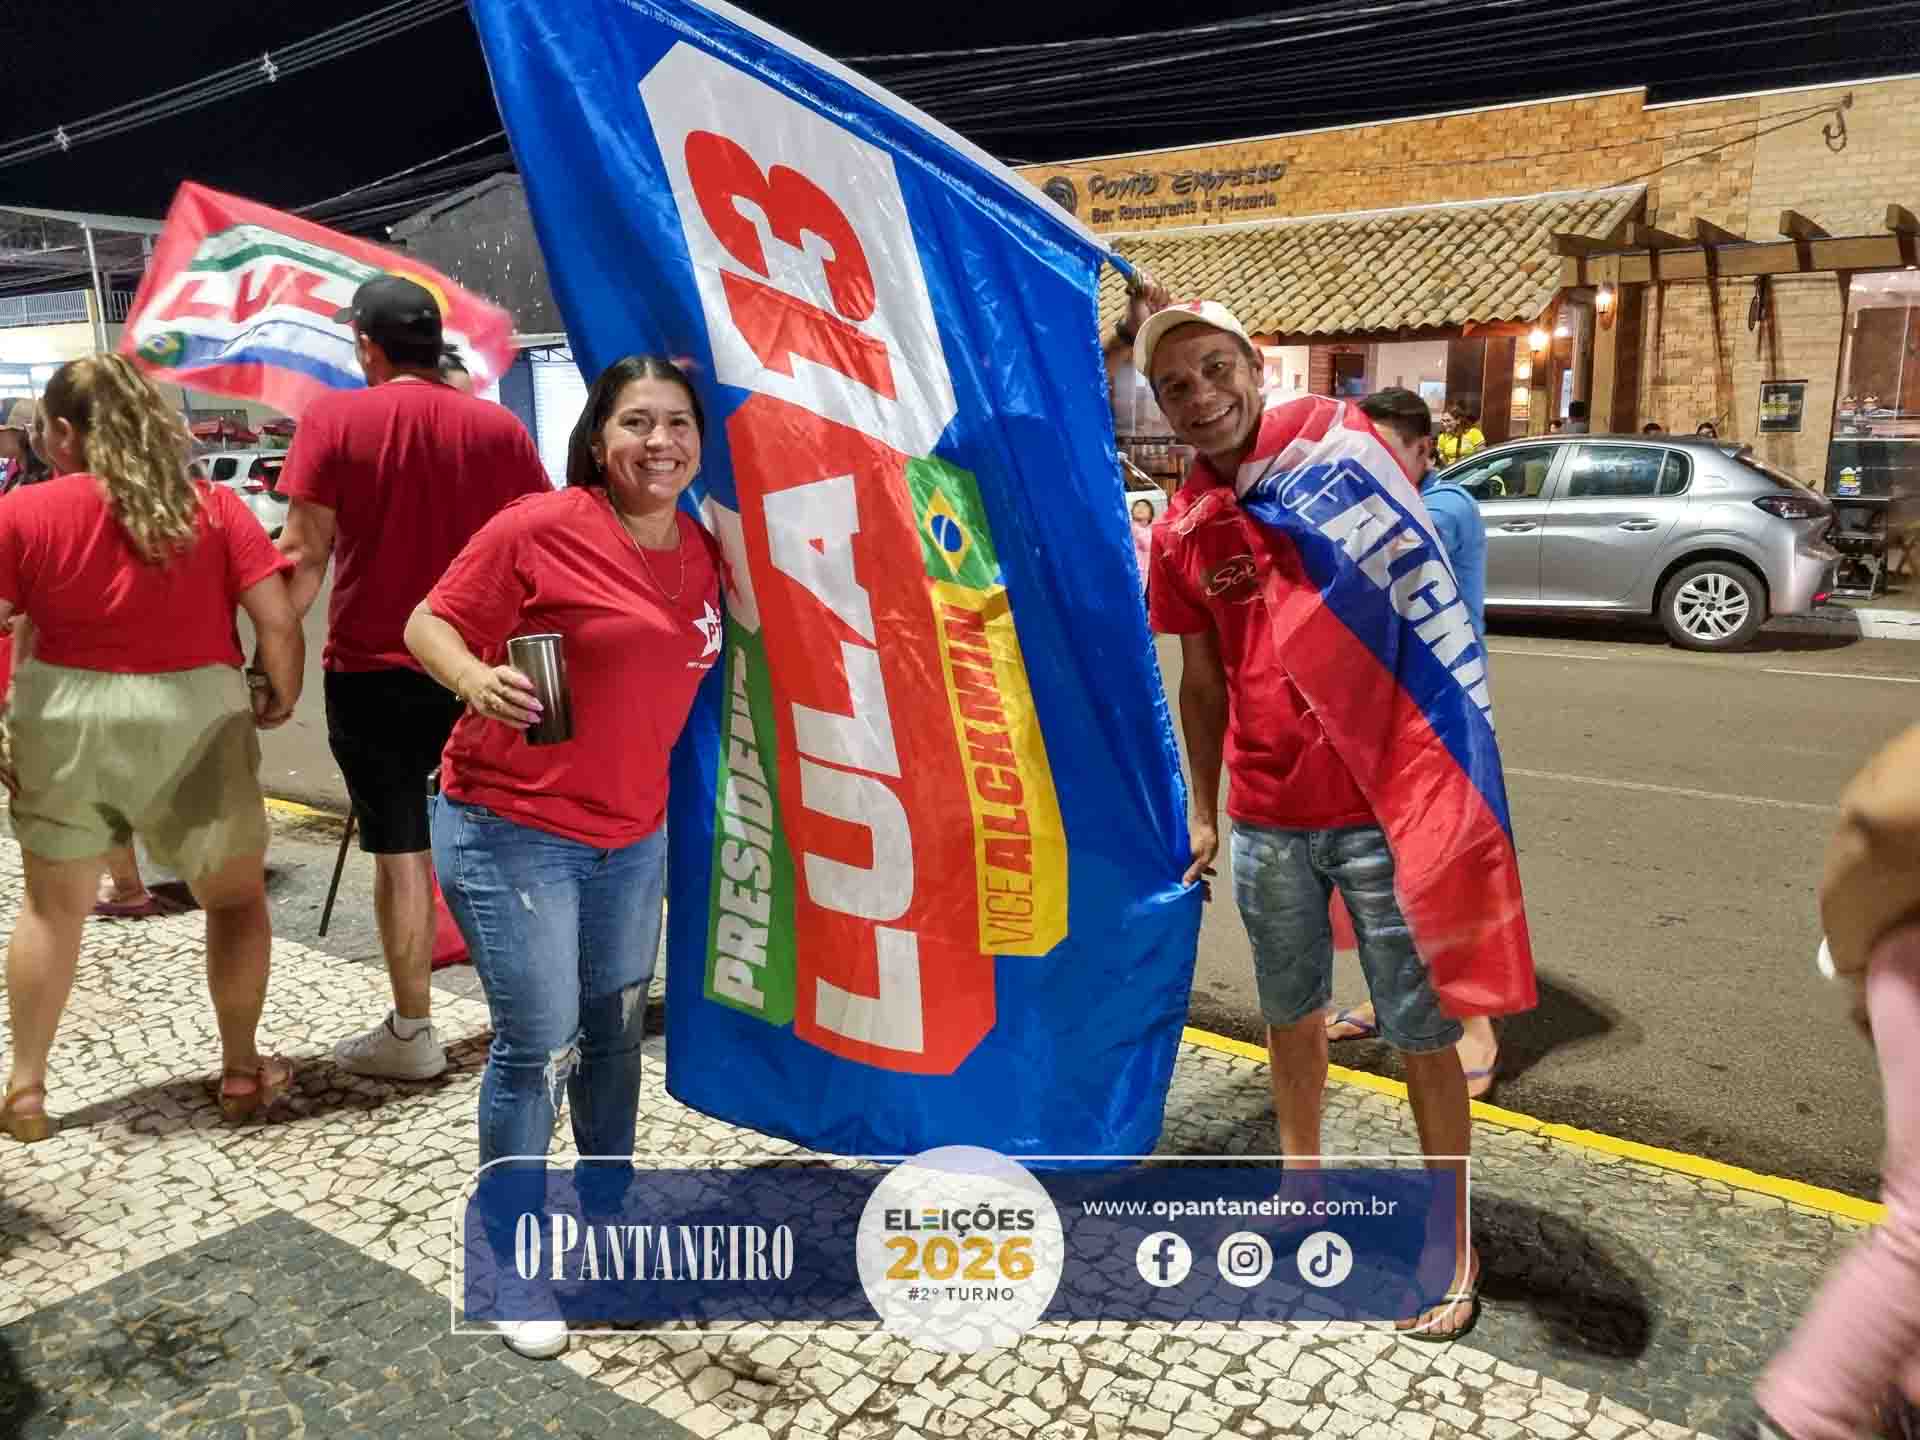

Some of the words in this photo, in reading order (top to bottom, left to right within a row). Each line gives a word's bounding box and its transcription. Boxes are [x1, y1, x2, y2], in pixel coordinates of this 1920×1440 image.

[684, 130, 898, 401] 13
[1091, 207, 1114, 224] Bar
[1119, 198, 1197, 221] Restaurante
[1202, 197, 1212, 212] e
[1217, 189, 1277, 211] Pizzaria
[158, 263, 353, 324] LUL
[762, 474, 924, 1054] LULA
[942, 603, 1033, 885] ALCKMIN
[984, 875, 1034, 946] VICE
